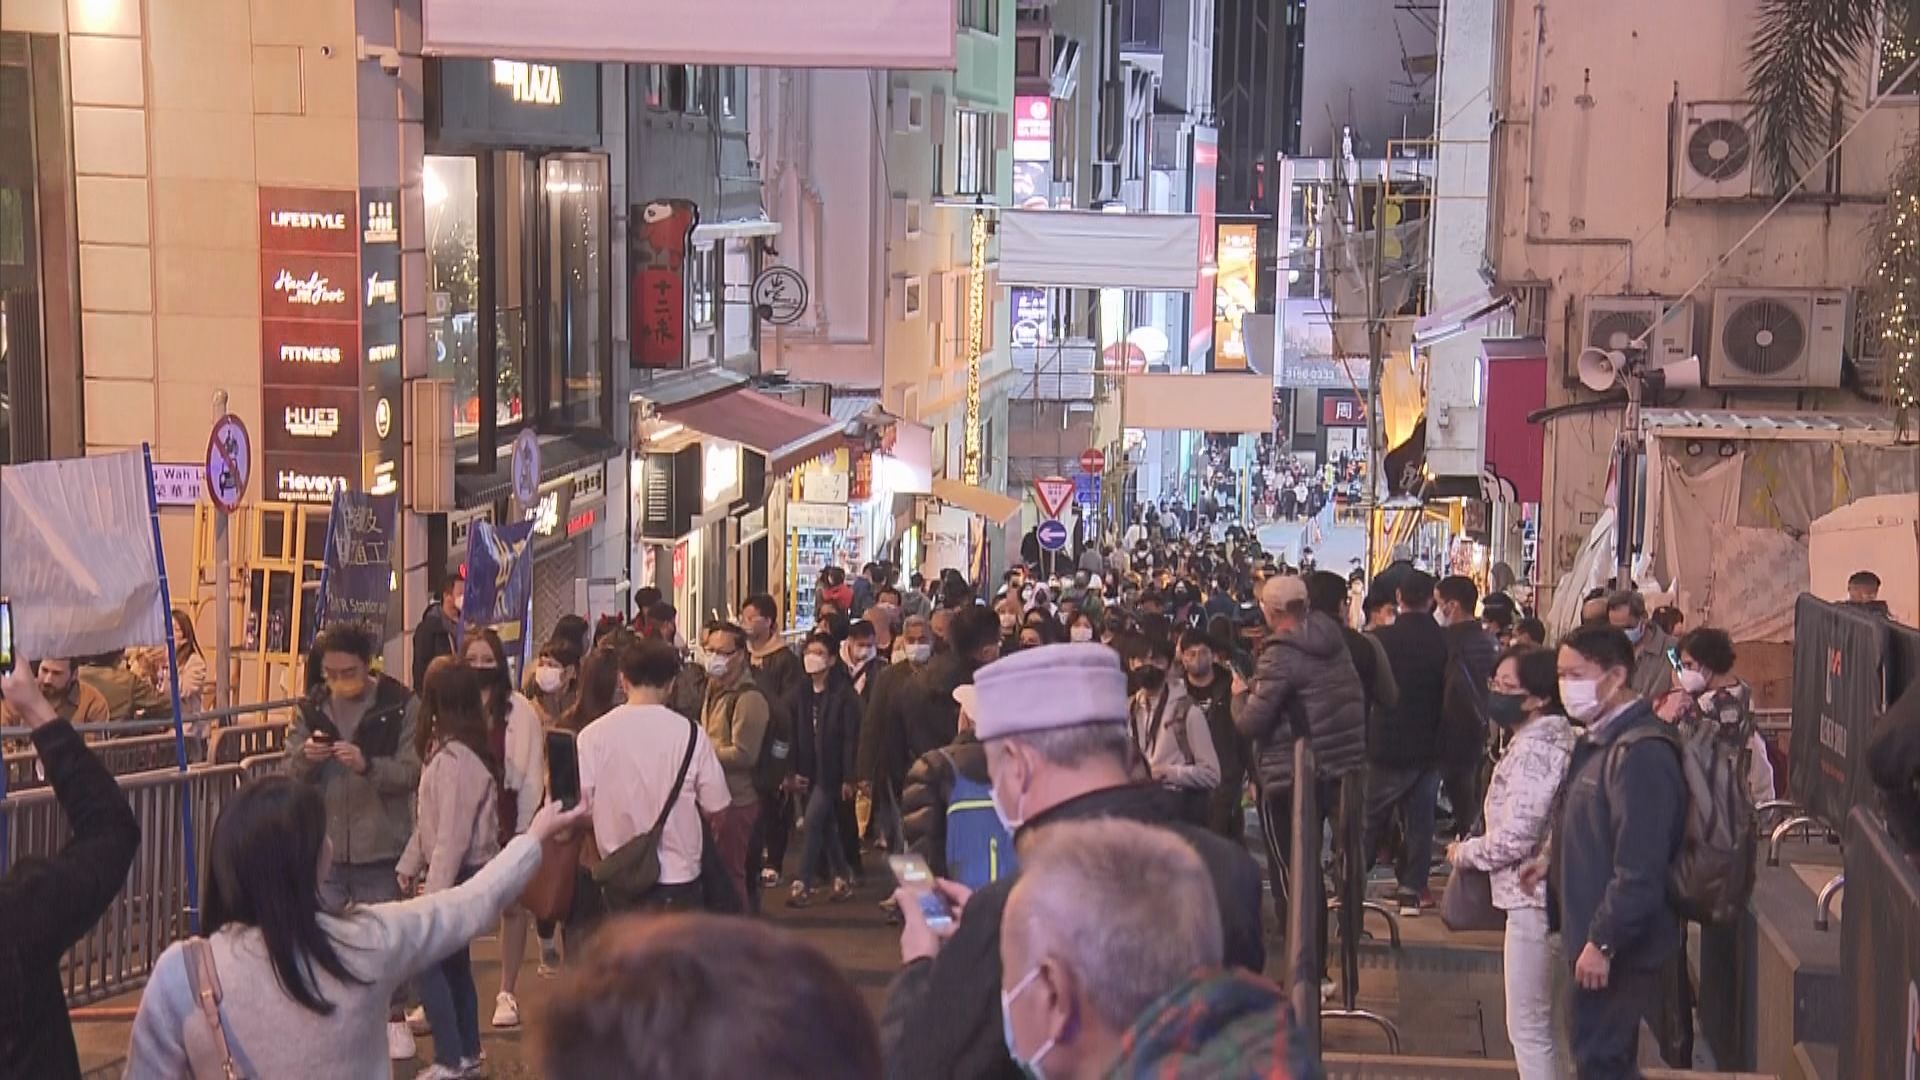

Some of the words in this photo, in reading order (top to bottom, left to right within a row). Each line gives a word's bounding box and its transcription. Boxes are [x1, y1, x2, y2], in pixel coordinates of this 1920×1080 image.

[270, 211, 345, 229] LIFESTYLE
[280, 344, 341, 363] FITNESS
[163, 468, 190, 479] Wah
